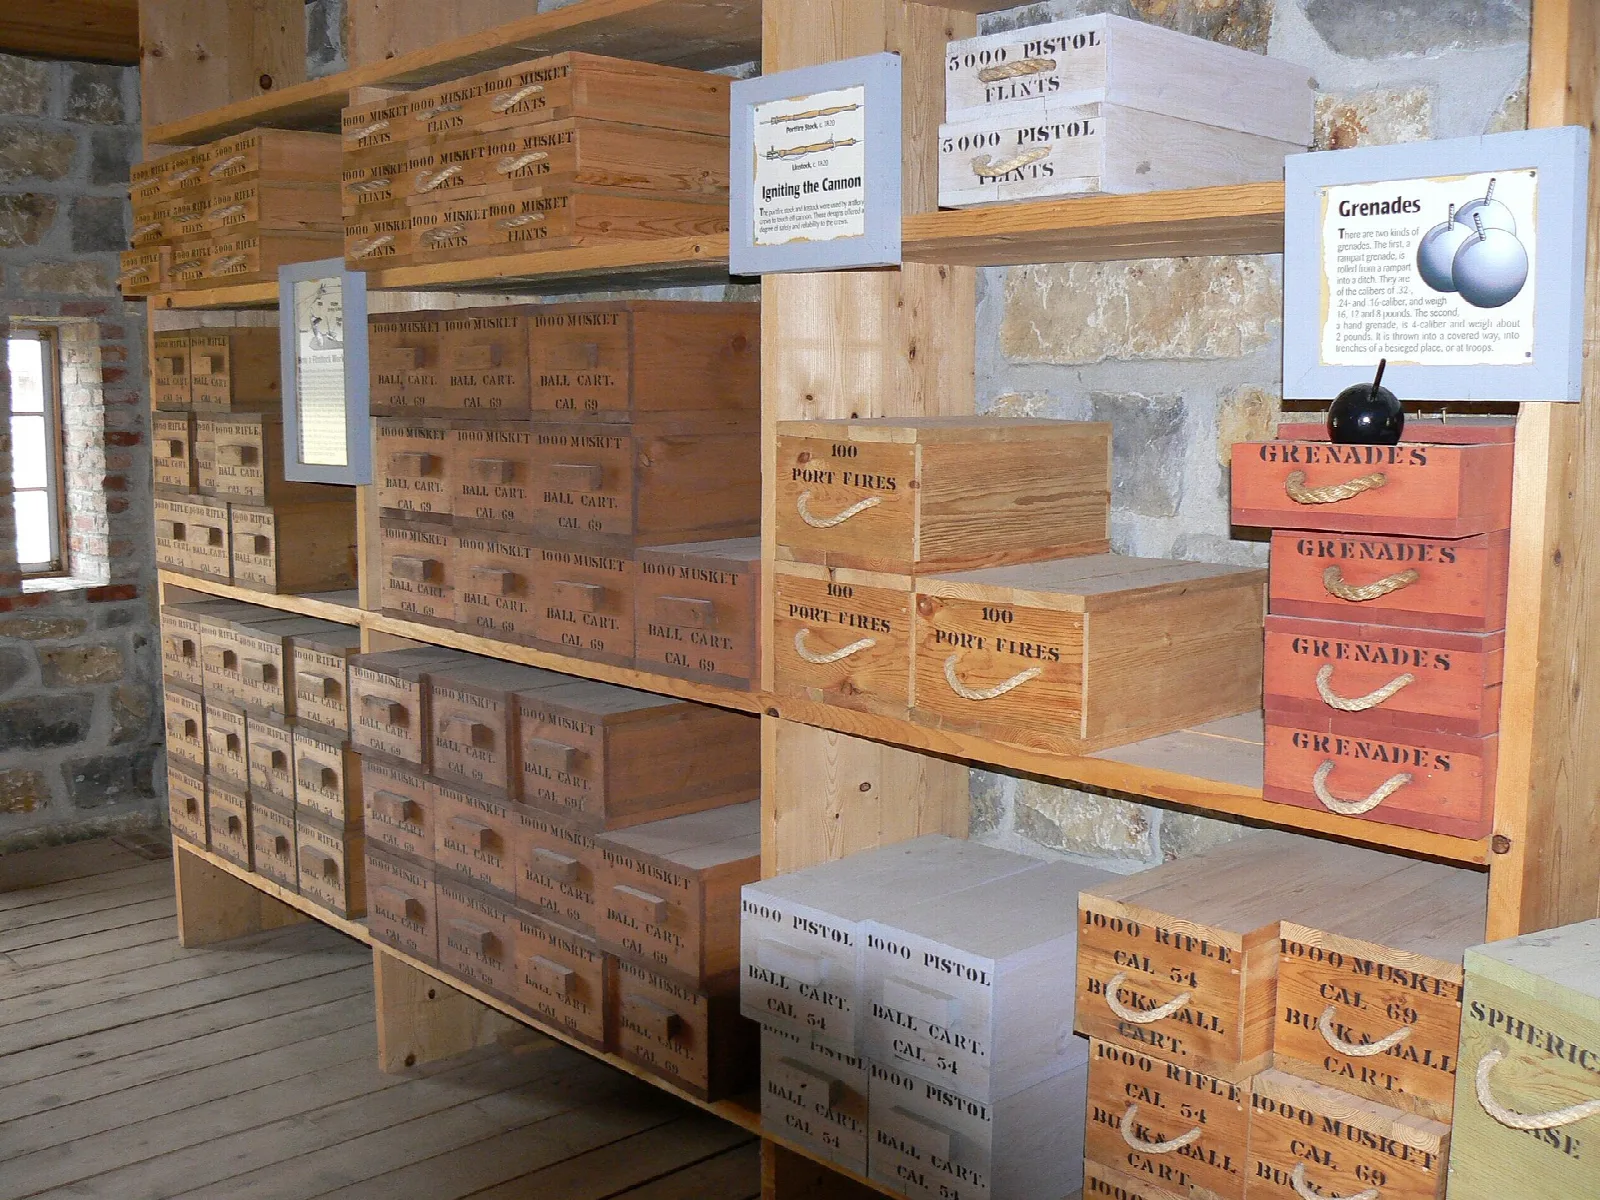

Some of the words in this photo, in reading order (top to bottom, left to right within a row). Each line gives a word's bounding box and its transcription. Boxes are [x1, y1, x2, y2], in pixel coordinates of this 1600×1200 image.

[949, 48, 1006, 71] 5000
[1023, 31, 1100, 58] PISTOL
[485, 78, 512, 92] 1000
[520, 66, 569, 85] MUSKET
[986, 76, 1060, 102] FLINTS
[235, 138, 255, 152] RIFLE
[488, 142, 516, 156] 1000
[523, 132, 574, 150] MUSKET
[943, 132, 1000, 152] 5000
[1018, 121, 1094, 144] PISTOL
[235, 188, 255, 200] RIFLE
[762, 182, 800, 202] Igniting
[803, 180, 819, 194] the
[822, 175, 861, 192] Cannon
[489, 201, 515, 215] 1000
[522, 196, 568, 212] MUSKET
[1339, 197, 1420, 217] Grenades
[508, 227, 547, 241] FLINTS
[1338, 228, 1360, 239] There
[1390, 227, 1410, 236] kinds
[1412, 227, 1420, 236] of
[1379, 274, 1397, 285] They
[535, 315, 564, 328] 1000
[568, 313, 619, 326] MUSKET
[1365, 321, 1398, 332] grenade,
[1450, 320, 1465, 328] and
[1468, 319, 1492, 330] weigh
[1496, 319, 1520, 327] about
[1336, 332, 1340, 341] 2
[1344, 332, 1373, 341] pounds.
[1376, 332, 1380, 340] It
[1384, 332, 1390, 340] is
[1392, 332, 1419, 340] thrown
[1422, 332, 1437, 340] into
[1447, 331, 1480, 340] covered
[1482, 333, 1500, 342] way,
[1336, 343, 1367, 352] trenches
[1369, 343, 1377, 352] of
[1385, 343, 1418, 354] besieged
[1420, 343, 1443, 353] place,
[1466, 344, 1494, 353] troops.
[540, 376, 570, 387] BALL
[577, 375, 614, 387] CART.
[555, 398, 576, 410] CAL
[584, 399, 598, 410] 69
[831, 444, 857, 458] 100
[1259, 445, 1427, 466] GRENADES
[218, 467, 236, 477] BALL
[791, 468, 835, 485] PORT
[844, 471, 896, 491] FIRES
[1296, 538, 1457, 564] GRENADES
[642, 562, 676, 577] 1000
[679, 566, 739, 586] MUSKET
[827, 583, 853, 599] 100
[789, 604, 832, 624] PORT
[838, 612, 891, 634] FIRES
[981, 607, 1013, 624] 100
[648, 624, 682, 642] BALL
[690, 631, 734, 651] CART.
[935, 629, 987, 649] PORT
[996, 636, 1060, 662] FIRES
[665, 652, 690, 669] CAL
[699, 658, 715, 672] 69
[1292, 637, 1451, 671] GRENADES
[549, 713, 596, 736] MUSKET
[1292, 731, 1451, 772] GRENADES
[602, 849, 633, 869] 1000
[636, 862, 691, 890] MUSKET
[607, 908, 638, 931] BALL
[646, 922, 685, 949] CART.
[742, 900, 782, 923] 1000
[793, 916, 853, 947] PISTOL
[1085, 910, 1141, 938] 1000
[1156, 926, 1232, 964] RIFLE
[622, 937, 645, 956] CAL
[653, 950, 668, 965] 69
[867, 934, 911, 960] 1000
[924, 952, 991, 986] PISTOL
[1114, 950, 1155, 974] CAL
[1170, 968, 1198, 988] 54
[1280, 939, 1343, 968] 1000
[1352, 957, 1463, 1003] MUSKET
[748, 964, 789, 990] BALL
[799, 983, 850, 1012] CART.
[768, 998, 796, 1019] CAL
[807, 1013, 826, 1031] 54
[1320, 983, 1366, 1009] CAL
[1387, 1003, 1417, 1024] 69
[873, 1003, 917, 1031] BALL
[929, 1020, 985, 1056] CART.
[1118, 1022, 1187, 1056] CART.
[1470, 1001, 1600, 1075] SPHERIC
[893, 1039, 925, 1062] CAL
[937, 1056, 958, 1075] 54
[1097, 1044, 1153, 1073] 1000
[1166, 1063, 1242, 1103] RIFLE
[1324, 1056, 1403, 1092] CART.
[872, 1064, 914, 1091] 1000
[926, 1084, 991, 1122] PISTOL
[1126, 1083, 1165, 1109] CAL
[1181, 1103, 1207, 1124] 54
[1252, 1093, 1313, 1126] 1000
[1322, 1117, 1437, 1169] MUSKET
[1128, 1152, 1194, 1190] CART.
[1290, 1140, 1337, 1170] CAL
[1356, 1164, 1386, 1186] 69
